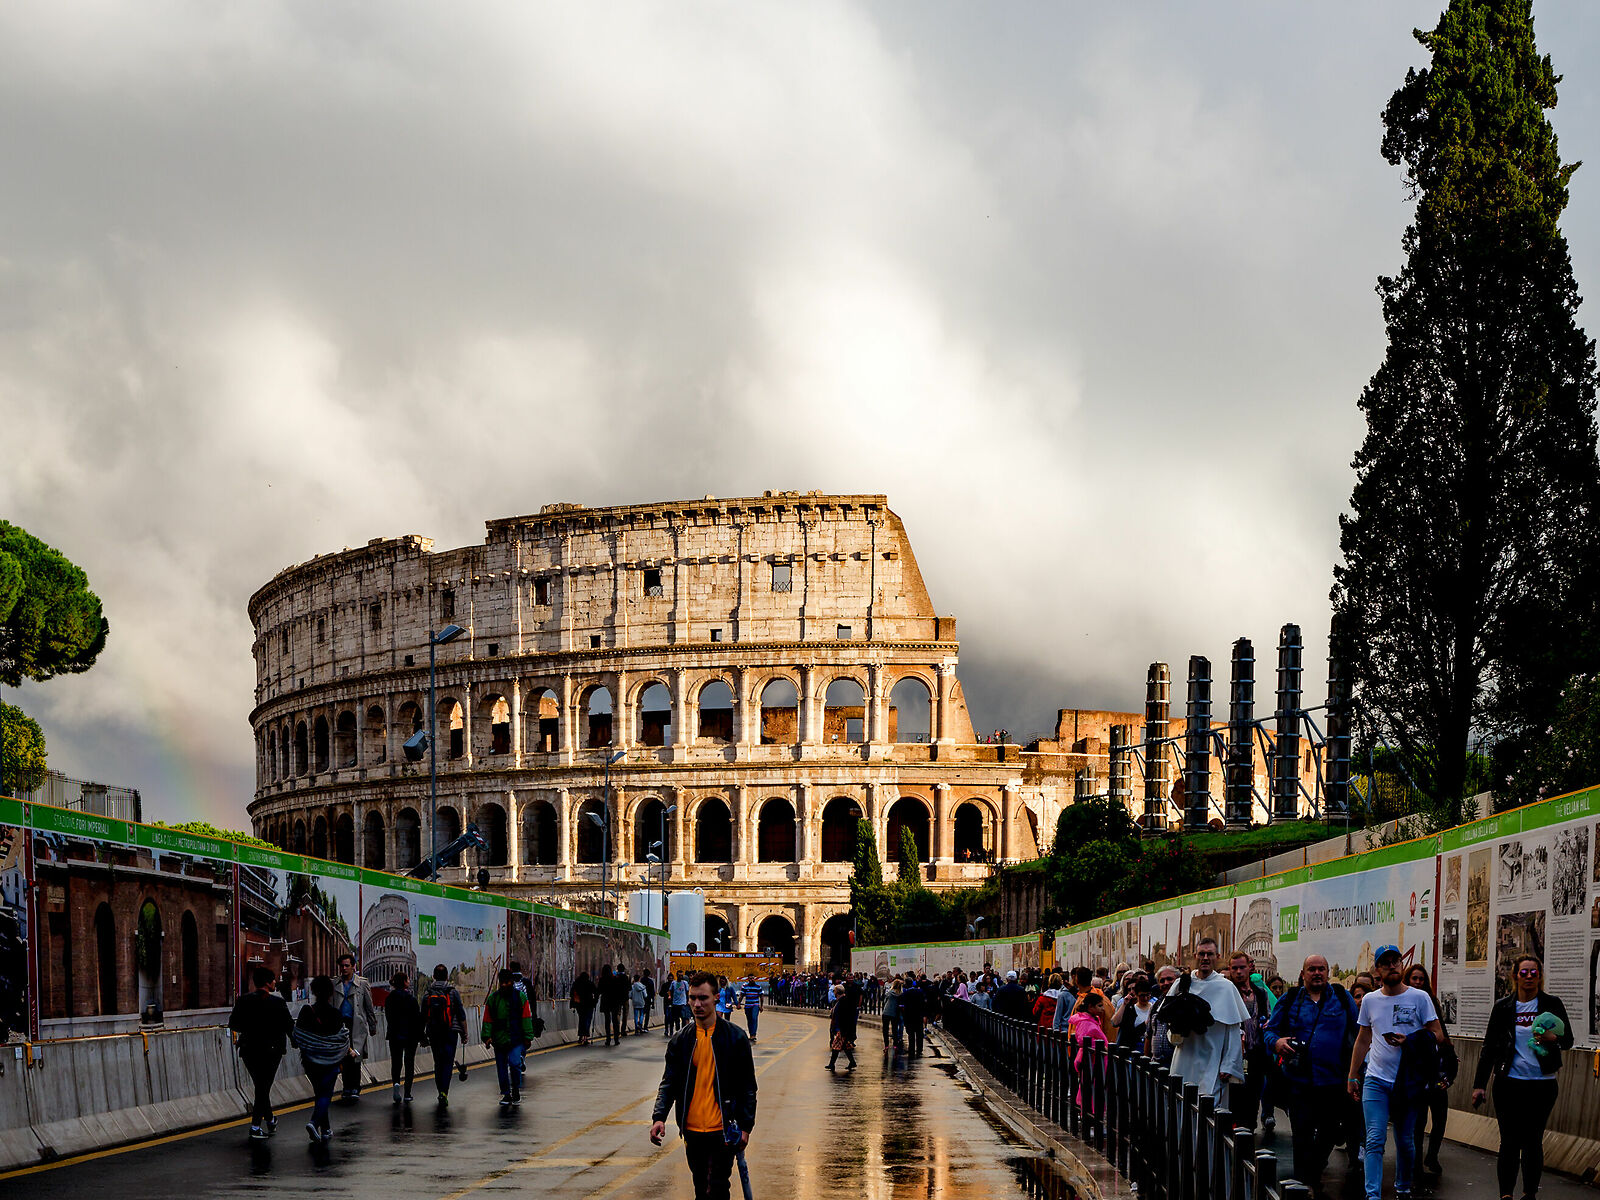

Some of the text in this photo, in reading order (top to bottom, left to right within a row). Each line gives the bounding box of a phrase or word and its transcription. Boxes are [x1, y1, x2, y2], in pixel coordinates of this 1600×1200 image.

[1323, 904, 1369, 929] METROPOLITANA
[1369, 902, 1376, 925] DI
[1377, 900, 1395, 924] ROMA
